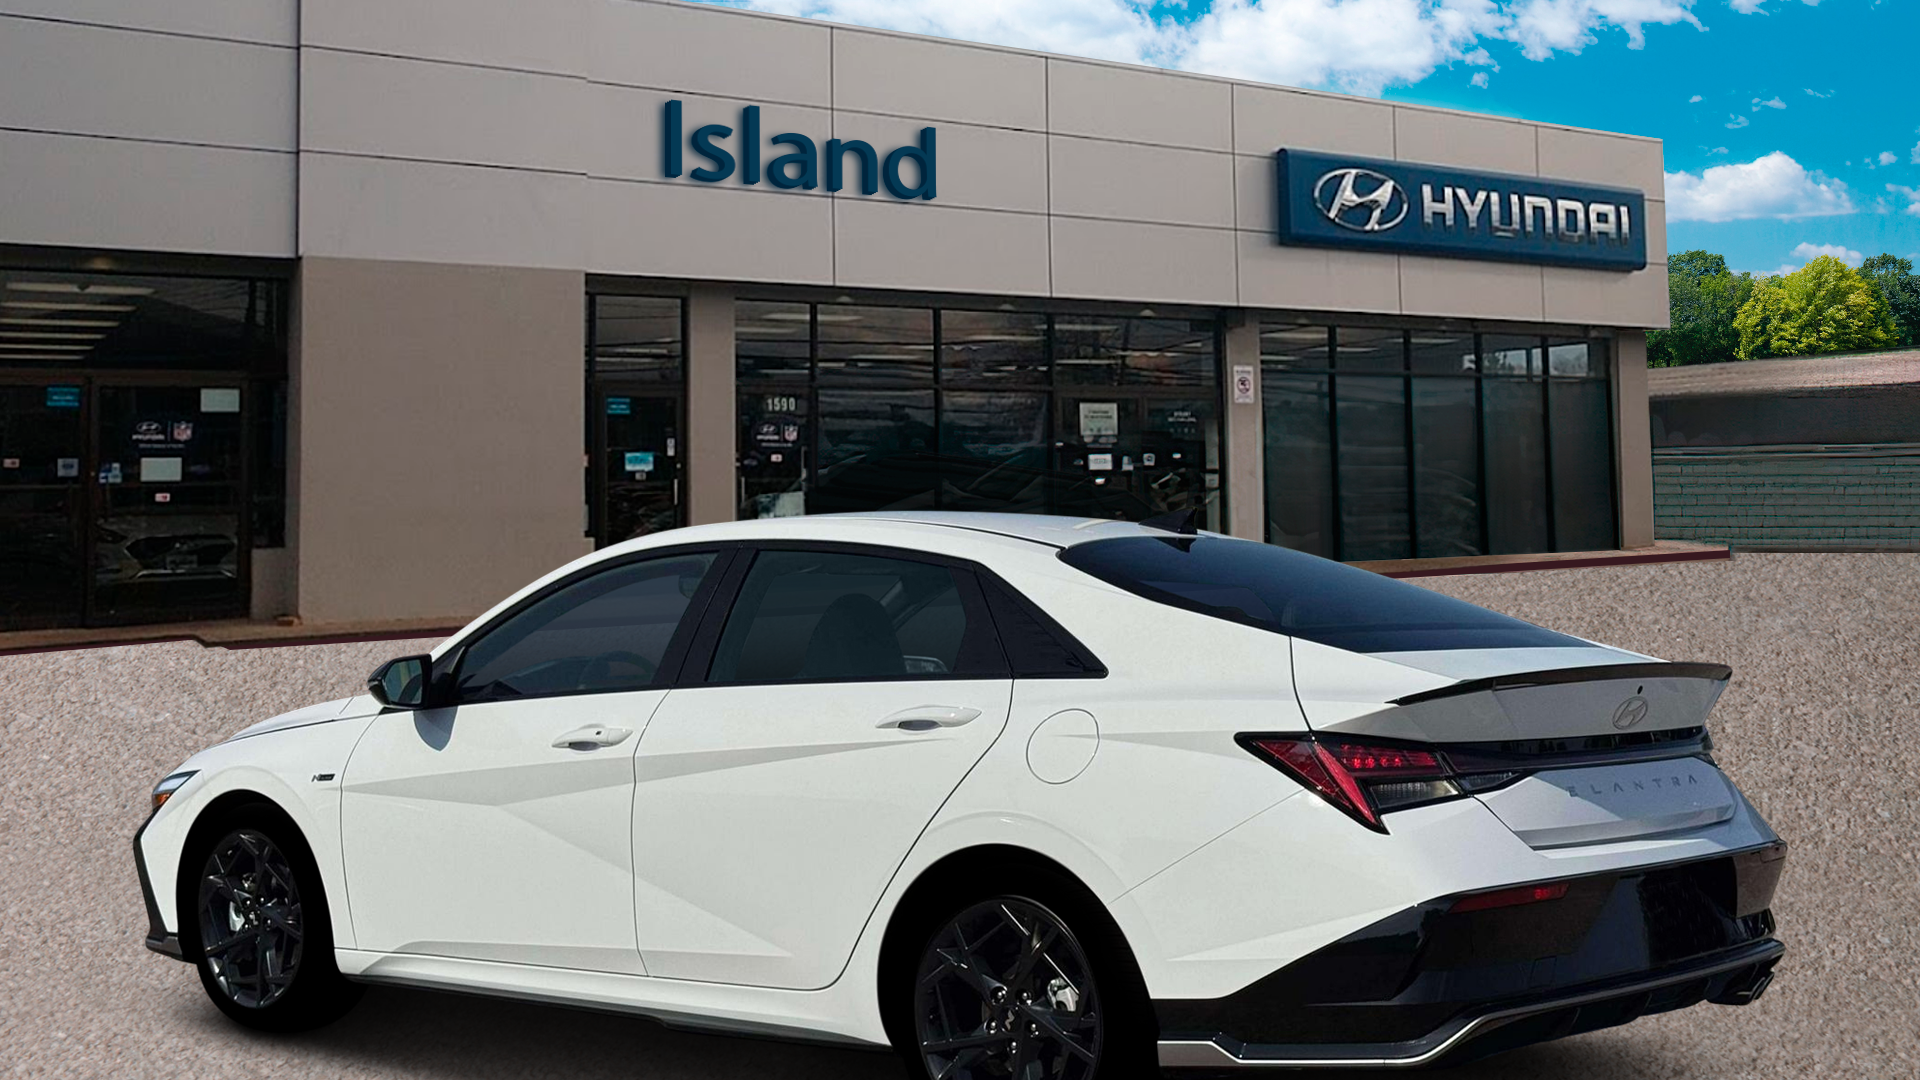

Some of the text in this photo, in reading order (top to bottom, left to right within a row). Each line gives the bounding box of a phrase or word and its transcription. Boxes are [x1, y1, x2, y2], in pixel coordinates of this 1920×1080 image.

[664, 99, 937, 201] Island
[1422, 184, 1630, 244] HYUNDAI
[766, 396, 797, 412] 1590
[1565, 774, 1699, 798] ELANTRA
